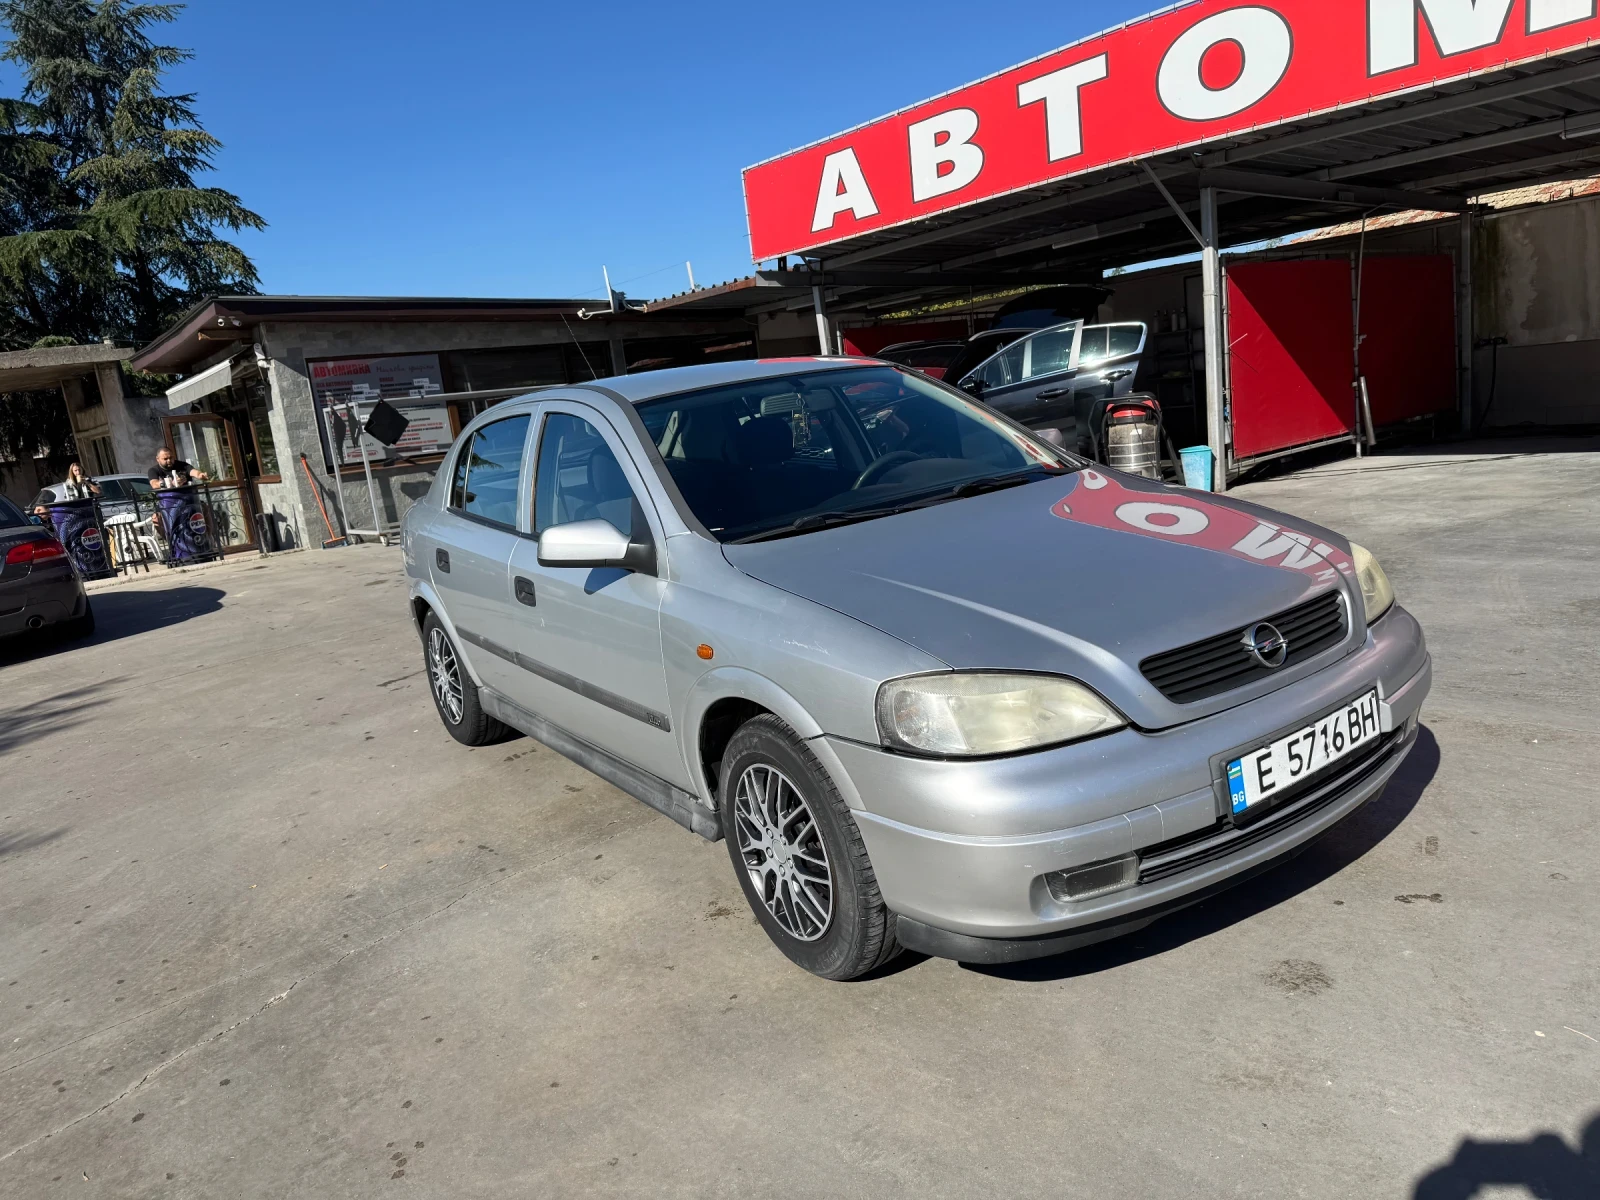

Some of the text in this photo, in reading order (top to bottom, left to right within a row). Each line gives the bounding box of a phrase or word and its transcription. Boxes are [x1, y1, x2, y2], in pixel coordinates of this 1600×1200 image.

[312, 364, 371, 378] АВТОМИВКА
[1255, 750, 1276, 794] E
[1286, 716, 1345, 777] 5716
[1231, 790, 1245, 806] BG
